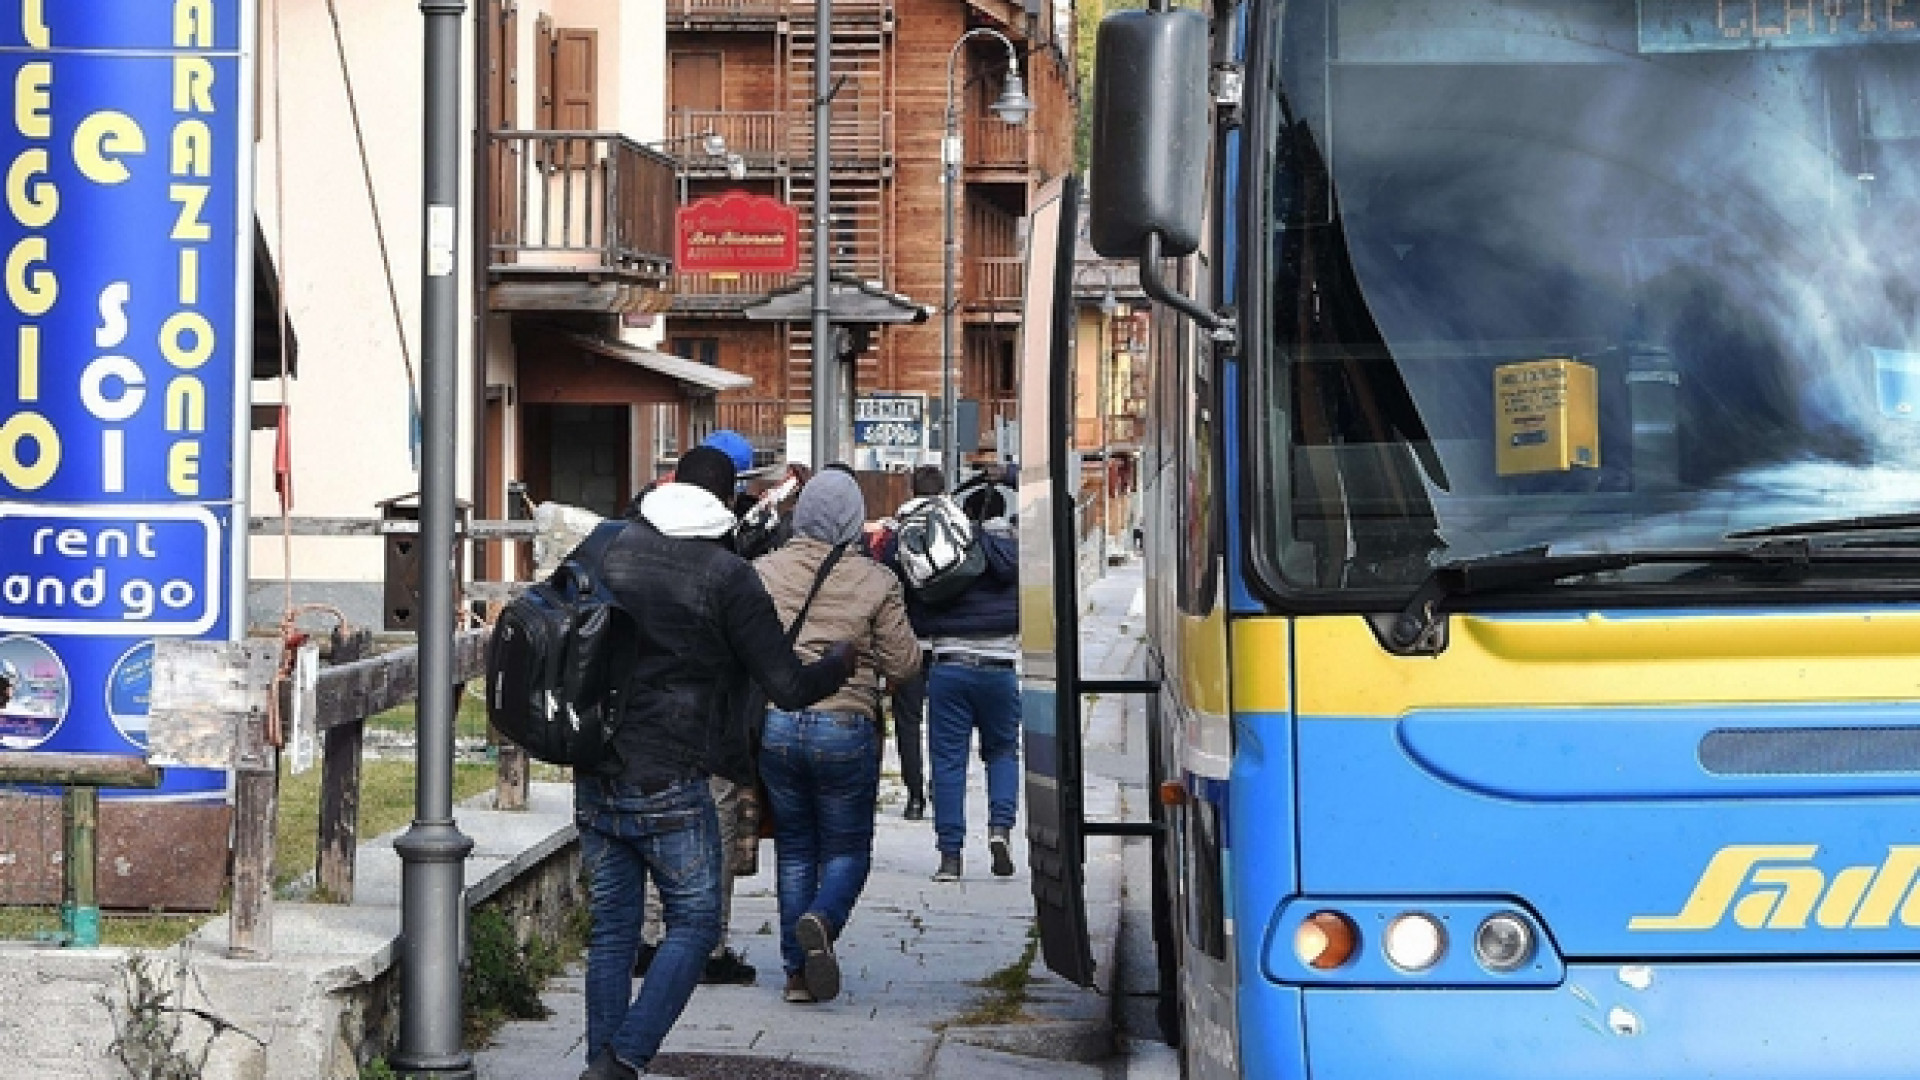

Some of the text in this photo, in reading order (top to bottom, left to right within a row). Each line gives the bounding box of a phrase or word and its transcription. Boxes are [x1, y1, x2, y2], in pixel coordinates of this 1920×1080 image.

[71, 109, 147, 184] e
[33, 522, 157, 559] rent
[3, 567, 195, 621] and go
